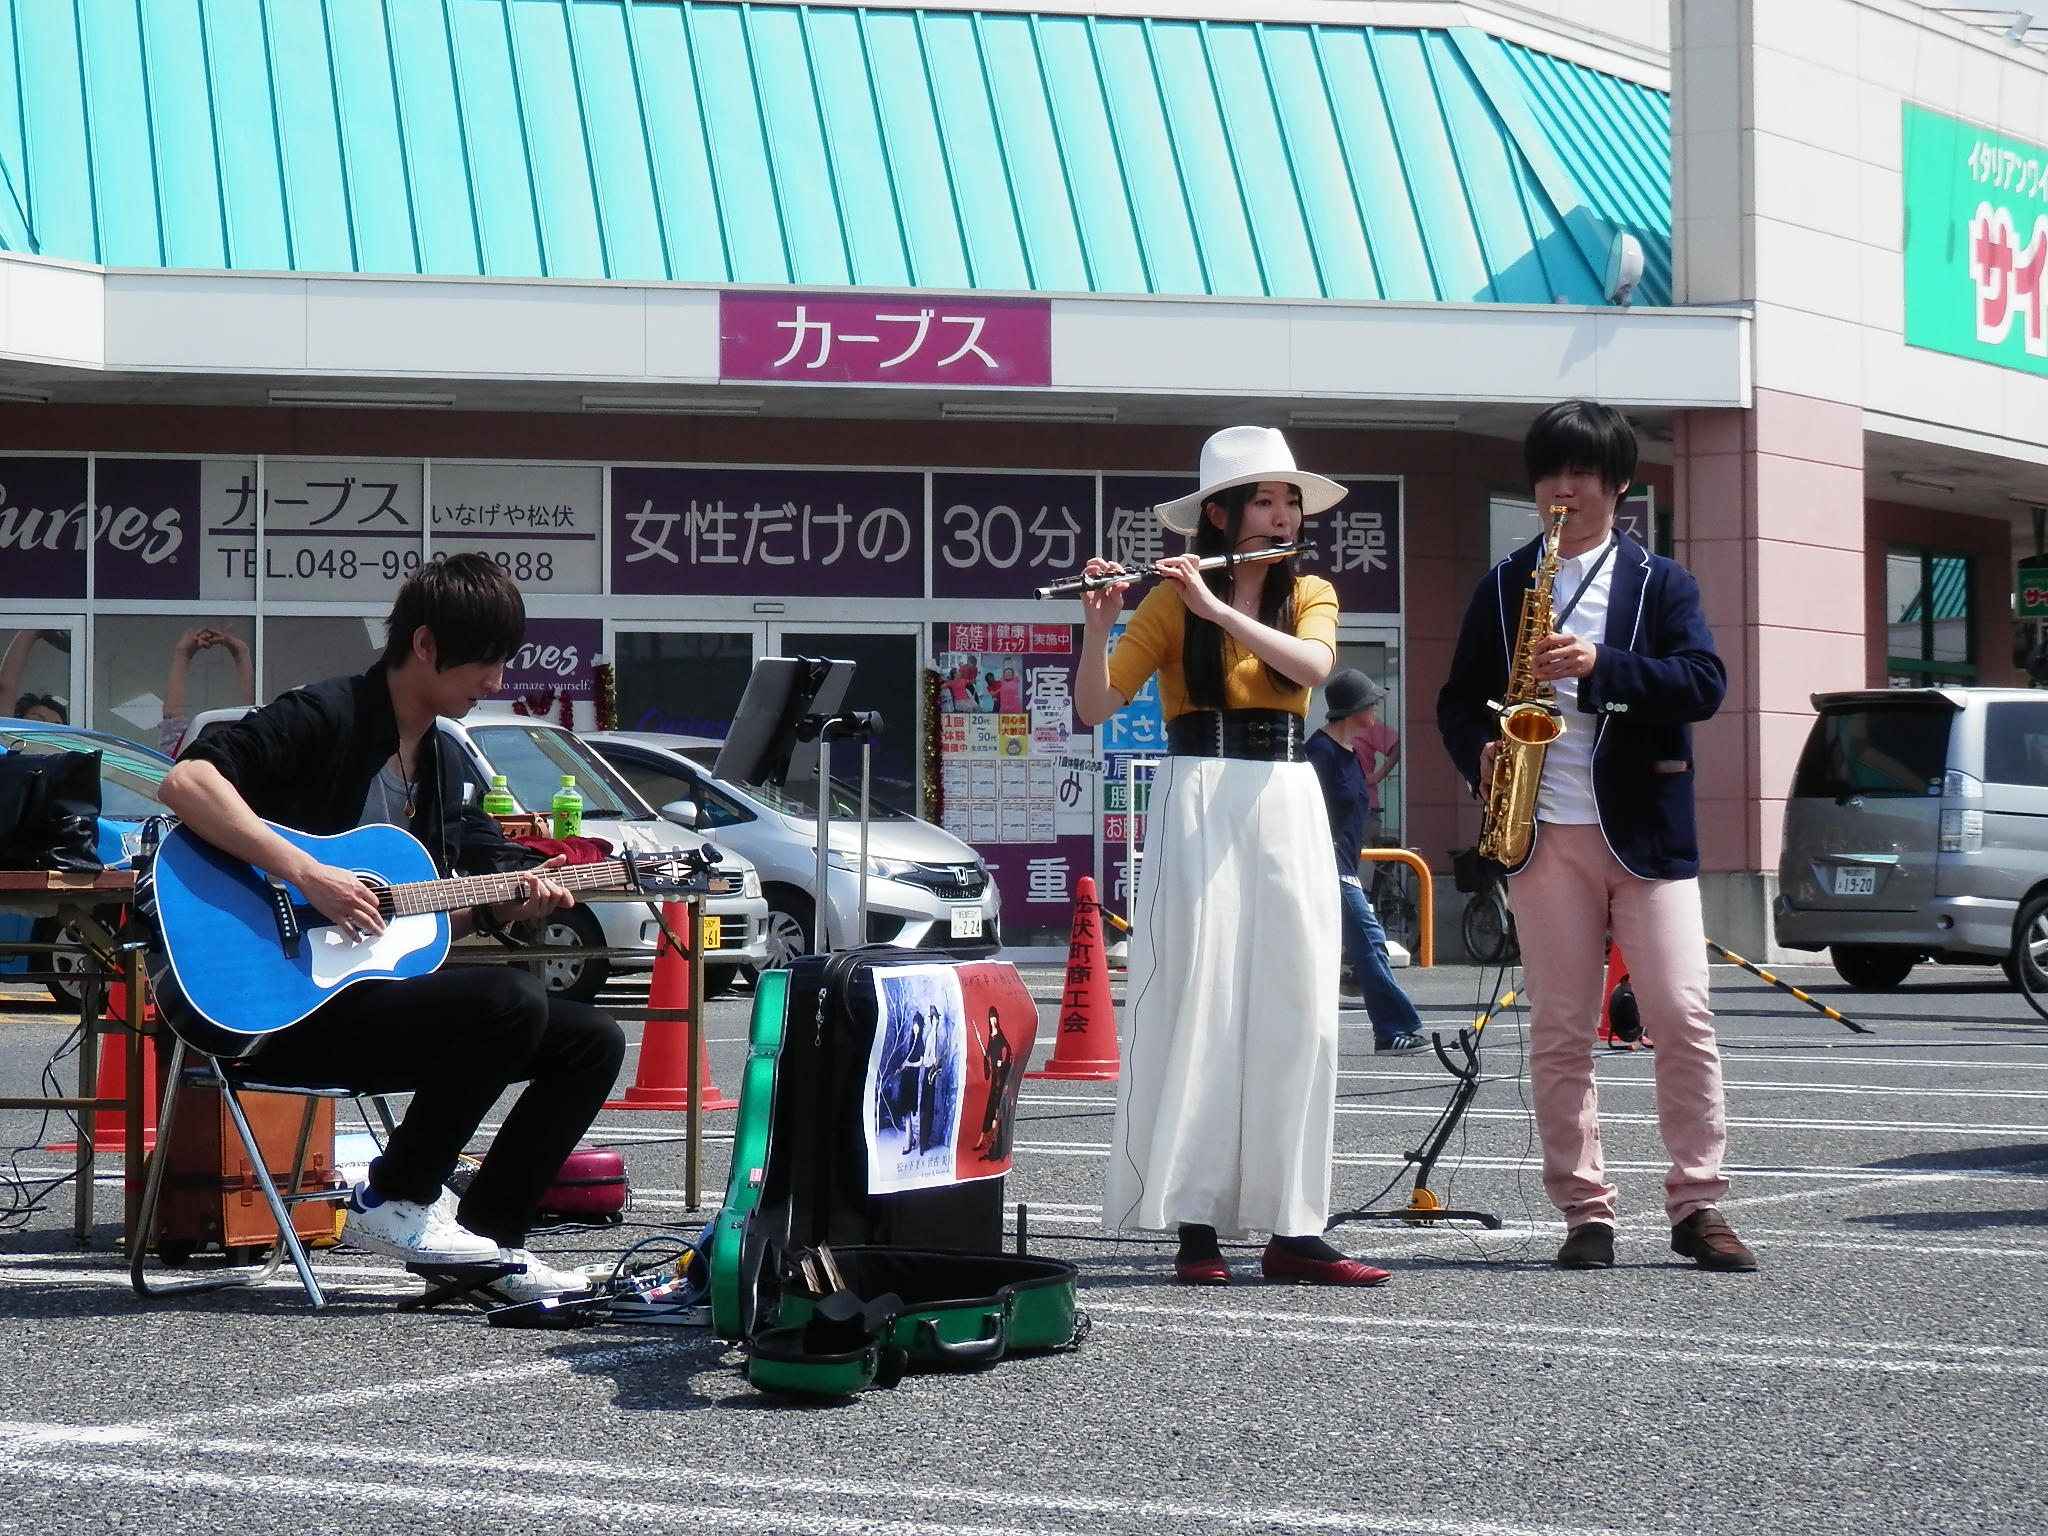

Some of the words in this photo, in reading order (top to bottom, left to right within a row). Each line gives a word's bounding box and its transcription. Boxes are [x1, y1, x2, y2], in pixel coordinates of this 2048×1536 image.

[774, 306, 999, 368] カーブス
[0, 487, 183, 565] urves
[222, 475, 409, 528] カーブス
[431, 504, 575, 527] いなげや松伏
[625, 499, 911, 566] 女性だけの
[942, 504, 1081, 570] 30分
[1105, 506, 1388, 573] 健操
[955, 624, 983, 637] 女性
[955, 636, 983, 651] 限定
[996, 638, 1025, 651] チェック
[1034, 634, 1069, 645] 実施中
[1026, 857, 1070, 902] 重
